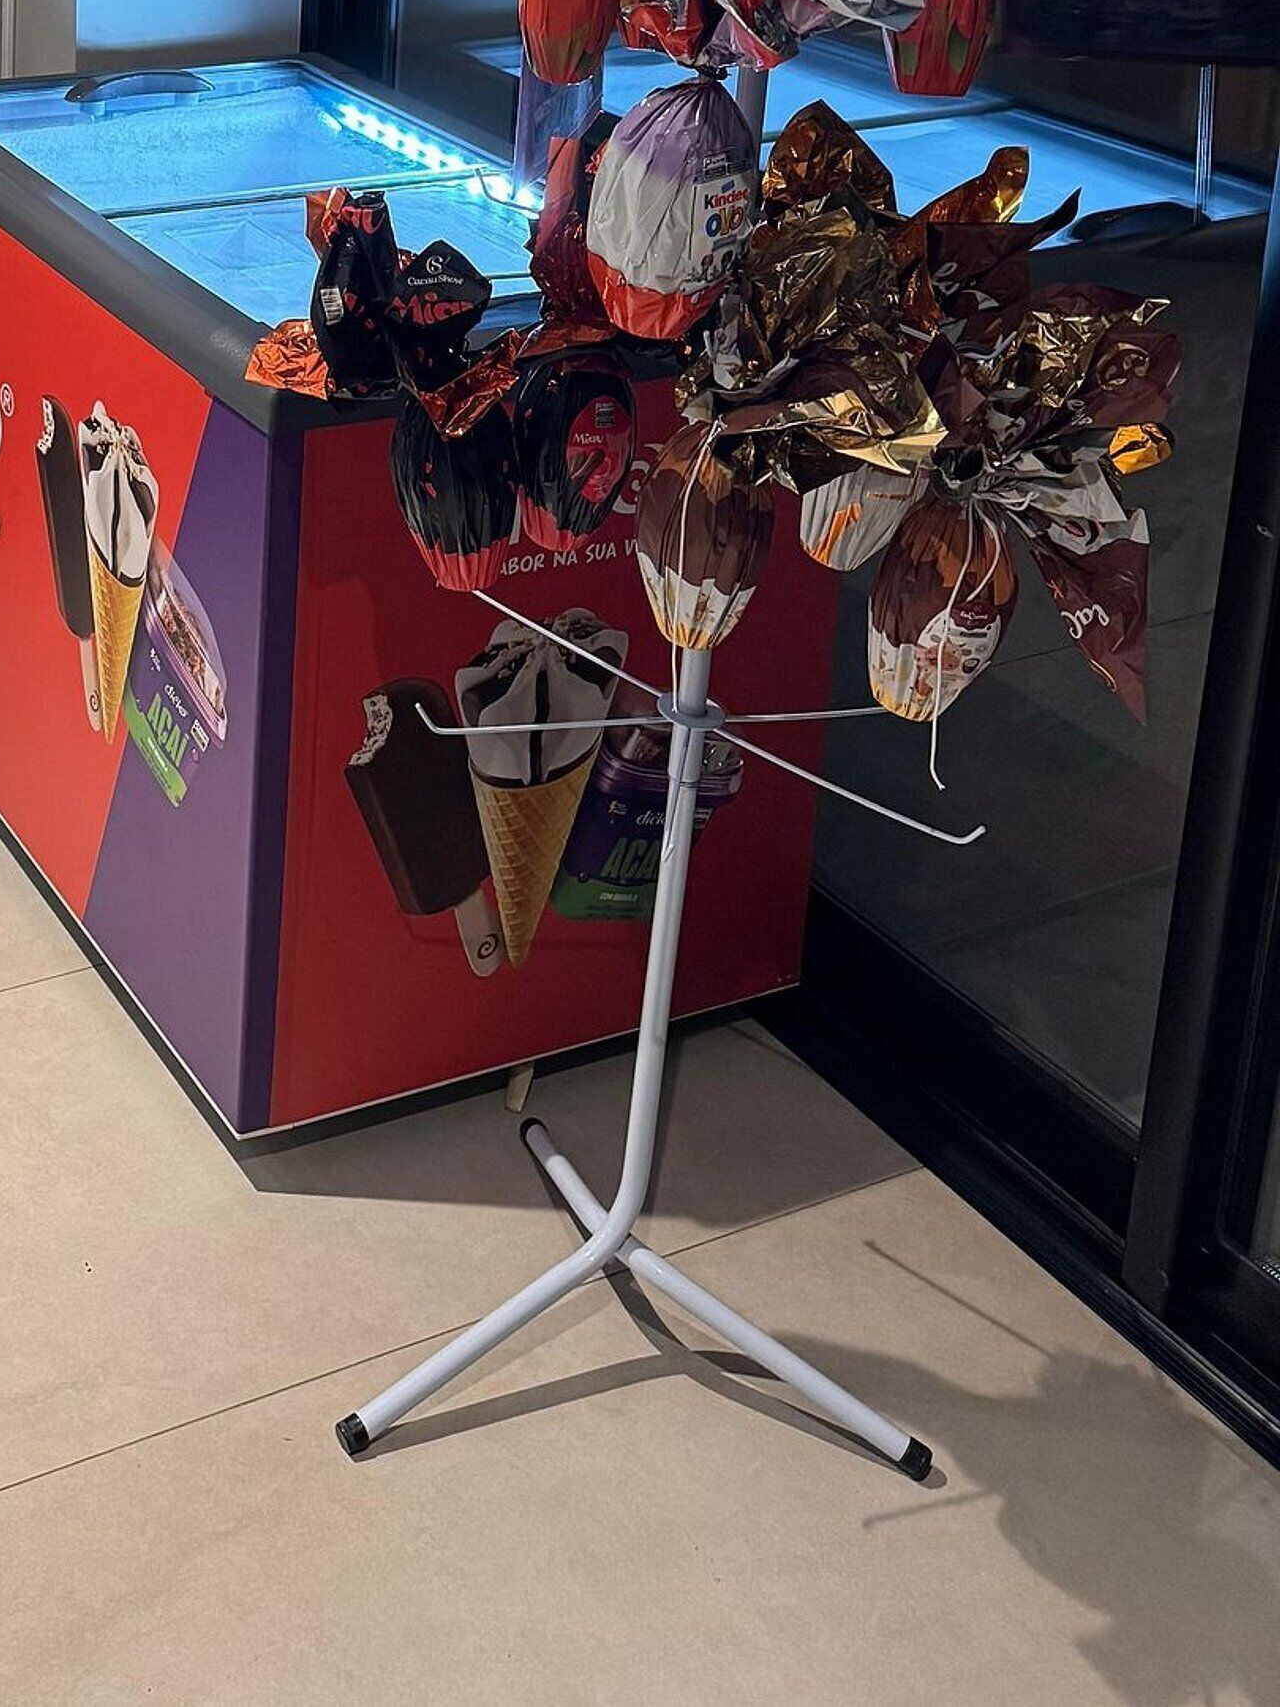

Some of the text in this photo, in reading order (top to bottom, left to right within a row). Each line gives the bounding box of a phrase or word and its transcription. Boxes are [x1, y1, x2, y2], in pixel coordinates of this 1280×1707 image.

[704, 189, 751, 210] Kinder
[552, 549, 579, 568] NA
[584, 540, 617, 563] SUA
[146, 692, 191, 768] AÇAÍ
[599, 836, 662, 884] AÇA
